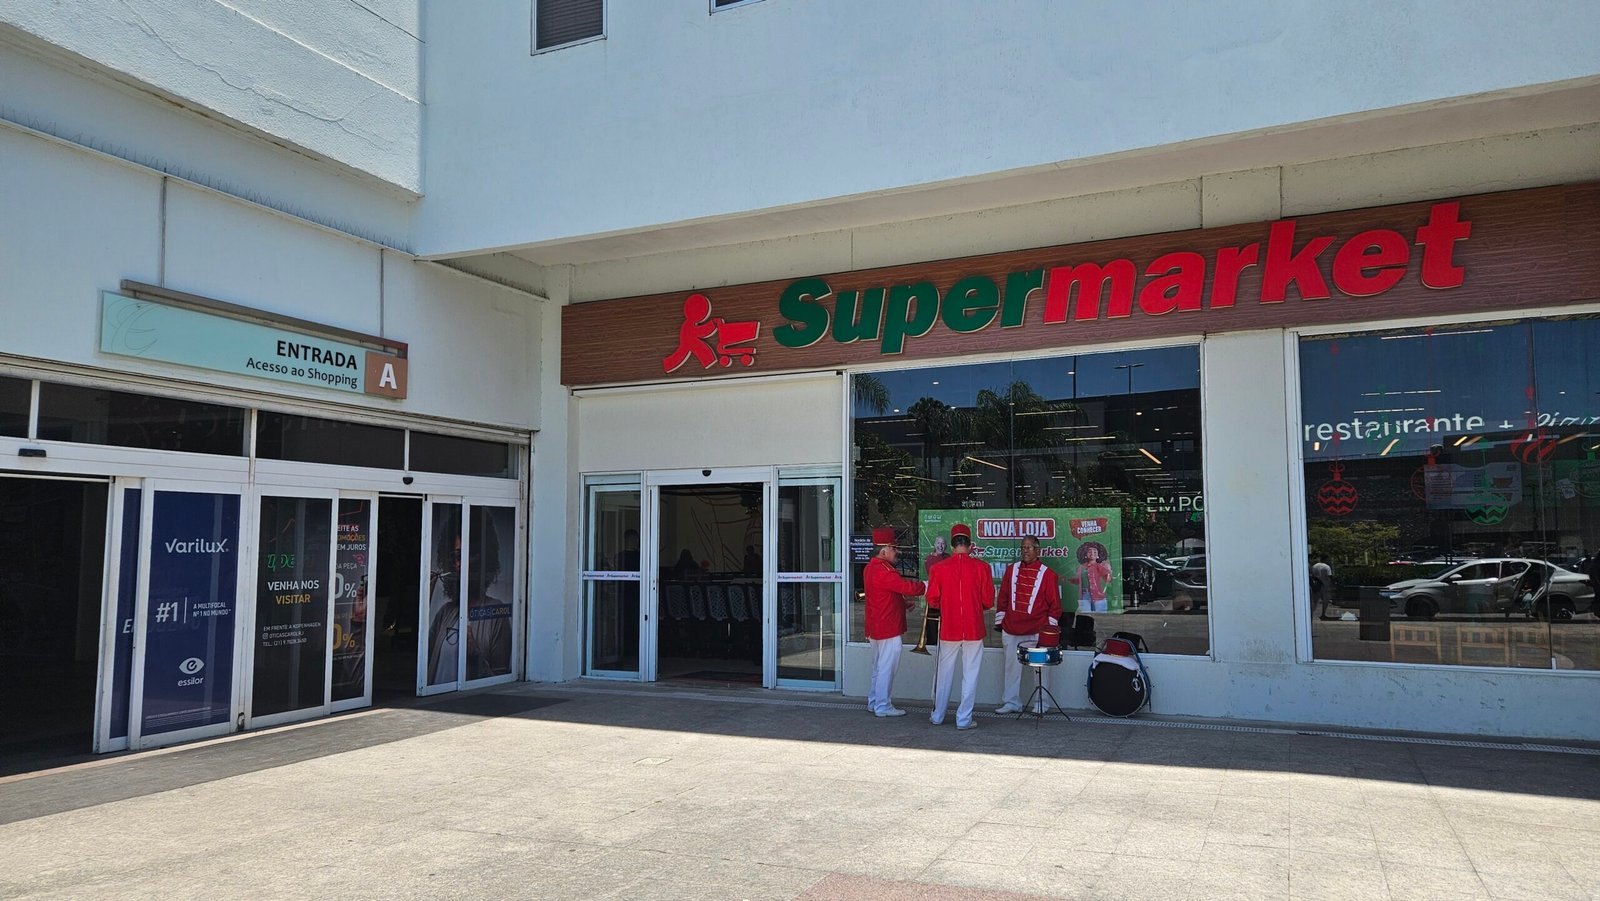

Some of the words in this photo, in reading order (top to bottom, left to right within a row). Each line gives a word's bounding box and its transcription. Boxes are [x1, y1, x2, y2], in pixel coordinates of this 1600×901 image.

[772, 201, 1472, 354] Supermarket
[276, 339, 358, 370] ENTRADA
[246, 357, 289, 375] Acesso
[291, 366, 305, 377] ao
[307, 367, 358, 389] Shopping
[379, 363, 397, 389] A
[1304, 412, 1485, 441] restaurante
[984, 521, 1015, 537] NOVA
[1019, 521, 1048, 537] LOJA
[1077, 526, 1102, 534] CONHECER
[984, 545, 1069, 559] Superrket
[343, 562, 357, 570] PEÇA
[267, 580, 299, 591] VENHA
[301, 579, 320, 590] NOS
[275, 594, 311, 605] VISITAR
[156, 602, 178, 623] #1
[177, 676, 204, 687] essilor
